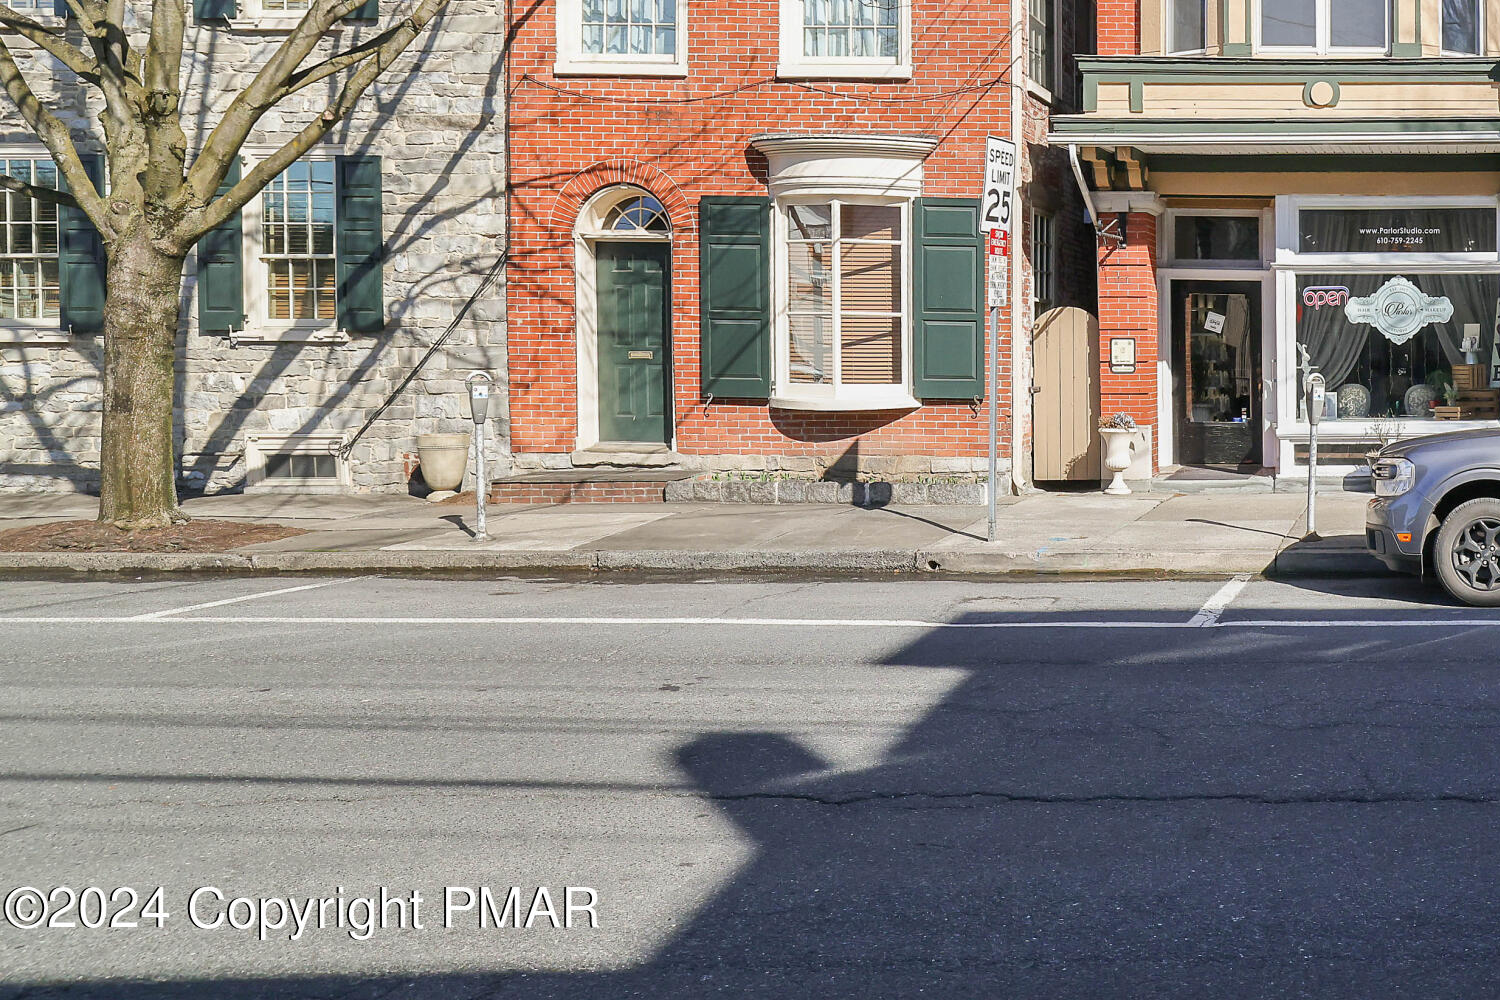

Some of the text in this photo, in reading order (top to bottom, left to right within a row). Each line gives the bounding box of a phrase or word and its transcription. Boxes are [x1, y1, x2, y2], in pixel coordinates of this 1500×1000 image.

[989, 148, 1013, 167] SPEED
[991, 169, 1011, 185] LIMIT
[985, 188, 1011, 224] 25
[1359, 227, 1440, 235] www.ParlorStudio.com
[1303, 291, 1349, 310] open
